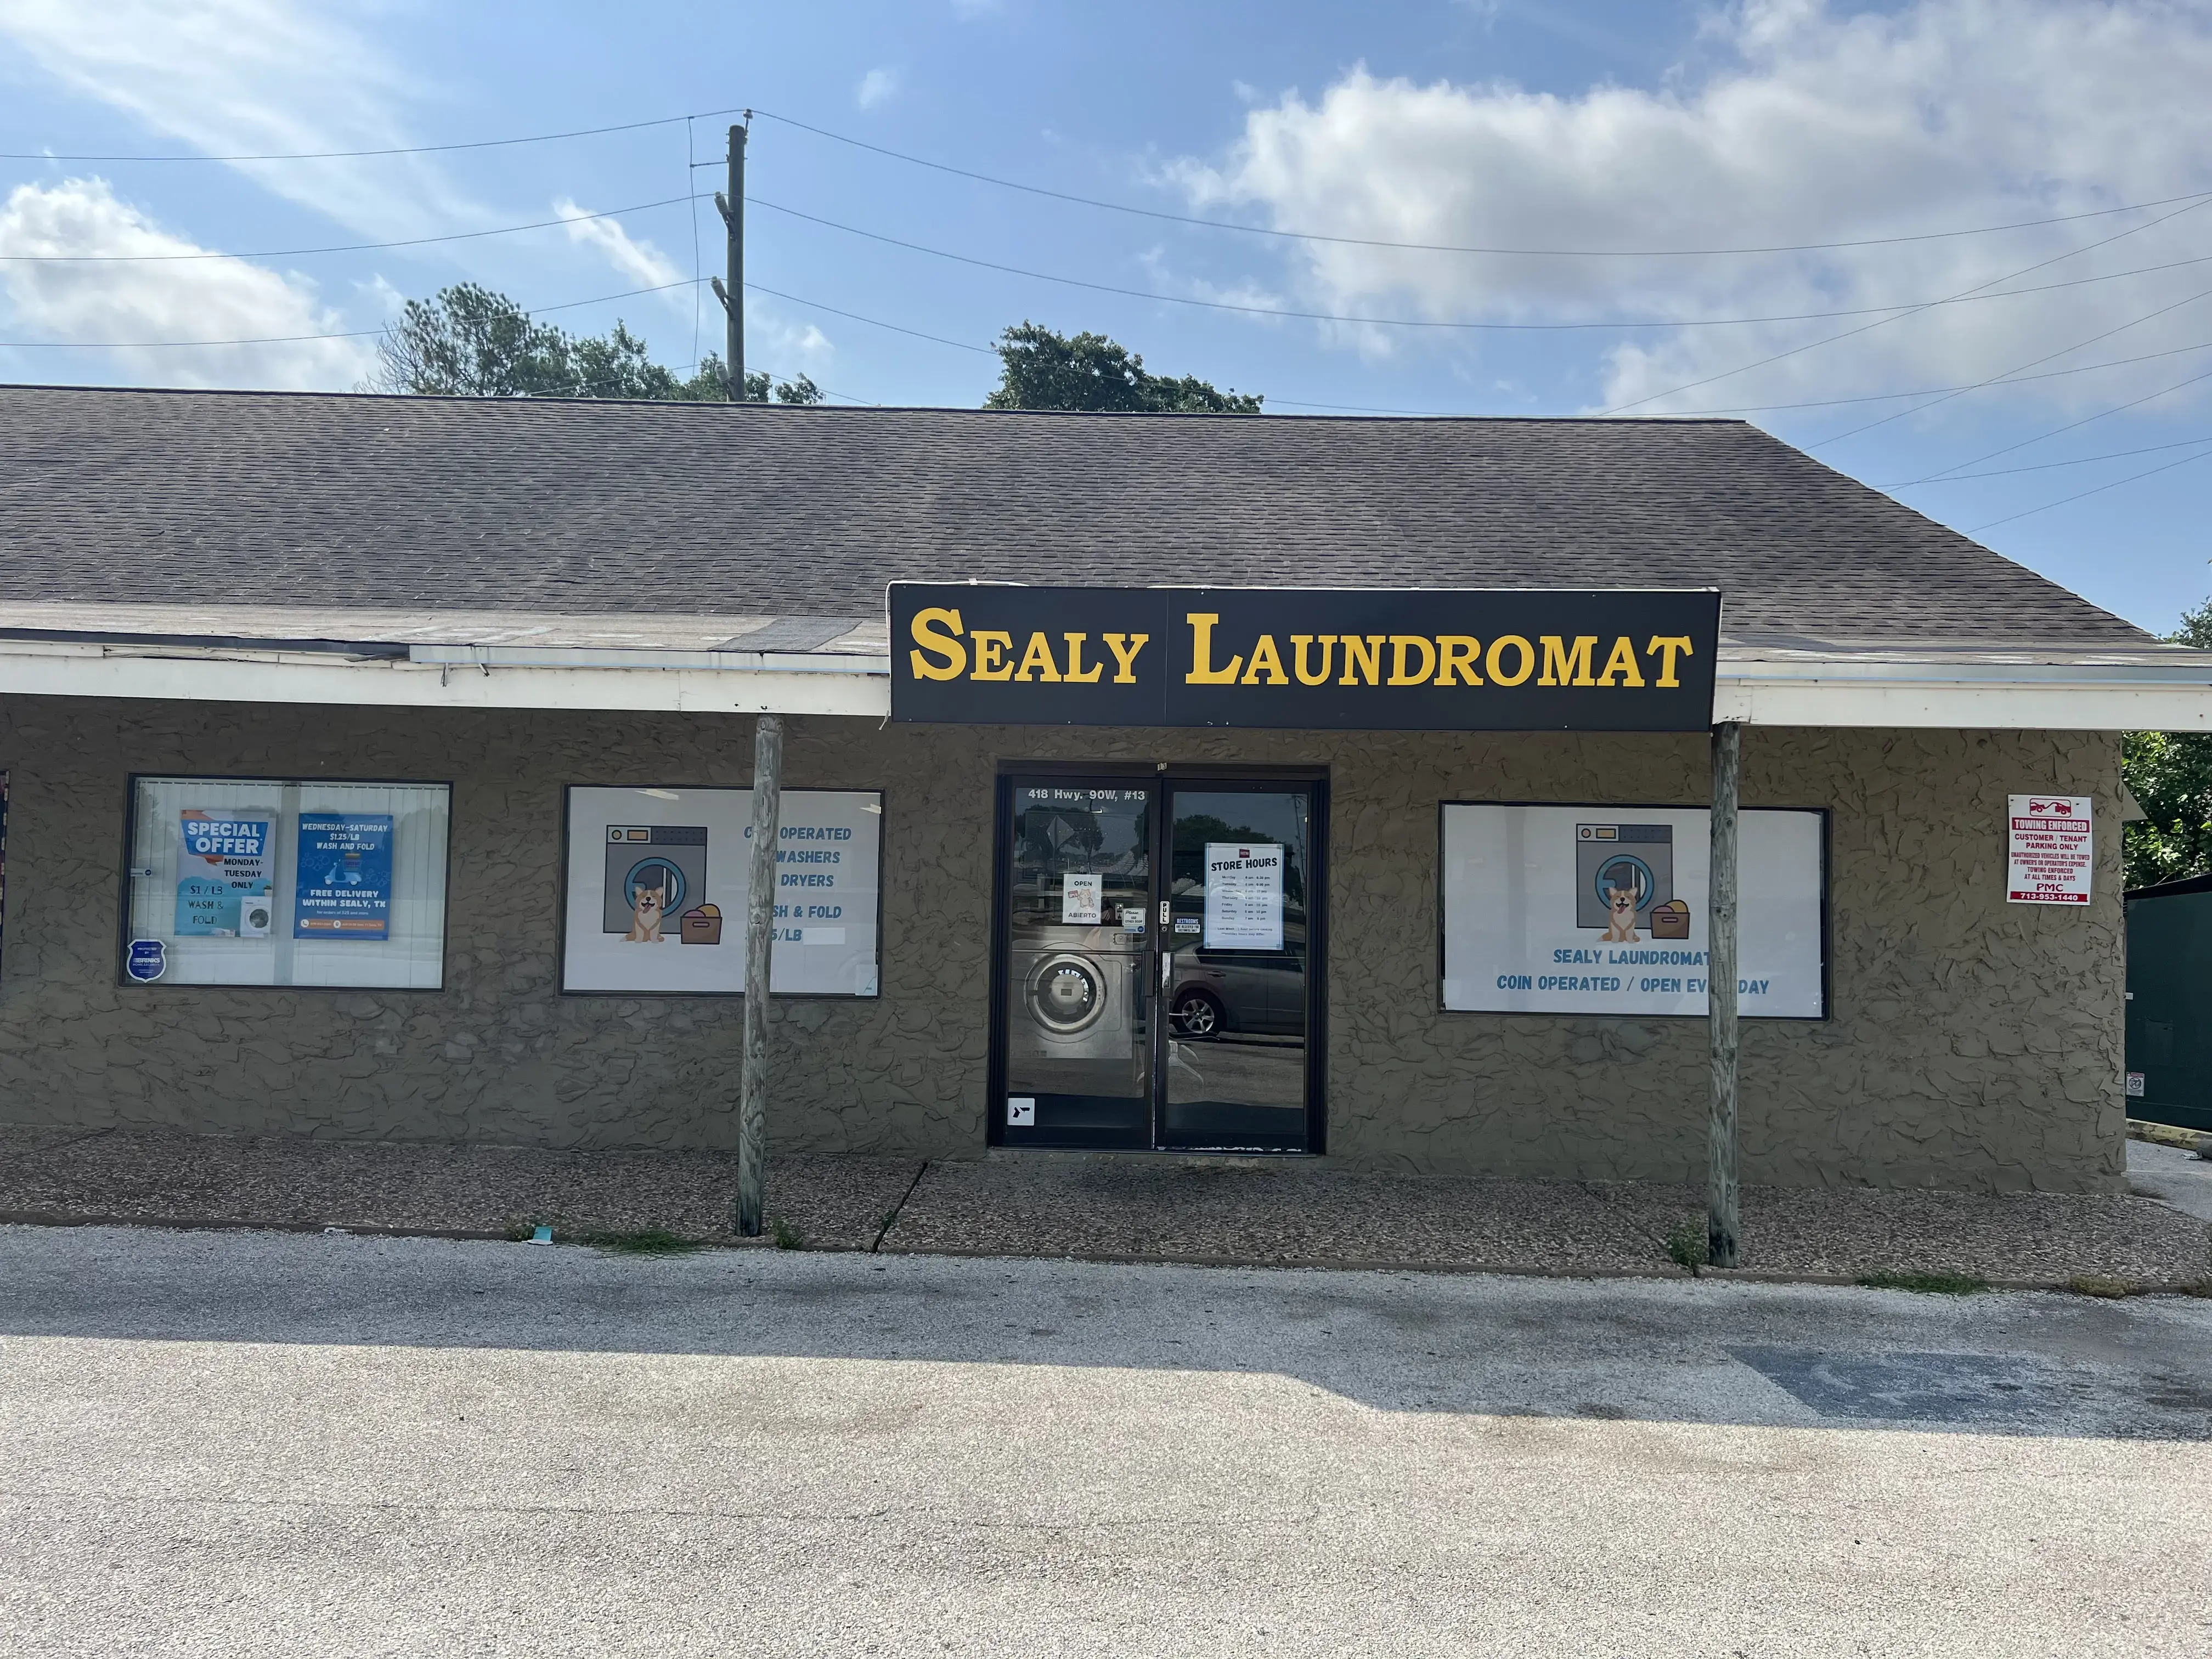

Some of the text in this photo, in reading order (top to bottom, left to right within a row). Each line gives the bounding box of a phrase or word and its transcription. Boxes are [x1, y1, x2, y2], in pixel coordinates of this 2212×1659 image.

[1028, 789, 1146, 802] 418 Hwy. 90W, #13
[188, 822, 260, 837] SPECIAL
[302, 823, 388, 832] WEDNESDAY-SATURDAY
[2015, 820, 2087, 831] TOWING ENFORCED
[330, 832, 360, 840] $1.25/LB
[780, 827, 852, 840] OPERATED
[196, 837, 259, 854] OFFER
[776, 850, 840, 864] WASHERS
[1211, 857, 1277, 871] STORE HOURS
[781, 874, 834, 887] DRYERS
[190, 885, 201, 894] $1
[2036, 883, 2063, 891] PMC
[2021, 893, 2078, 901] 713-953-1440
[188, 900, 223, 910] WASH &
[302, 899, 337, 907] WITHIN
[340, 899, 371, 909] SEALY,
[793, 906, 803, 918] &
[808, 906, 842, 918] FOLD
[193, 915, 217, 924] FOLD
[1553, 949, 1711, 966] SEALY LAUNDROMAT
[1497, 975, 1769, 994] COIN OPERATED / OPEN EVDAY
